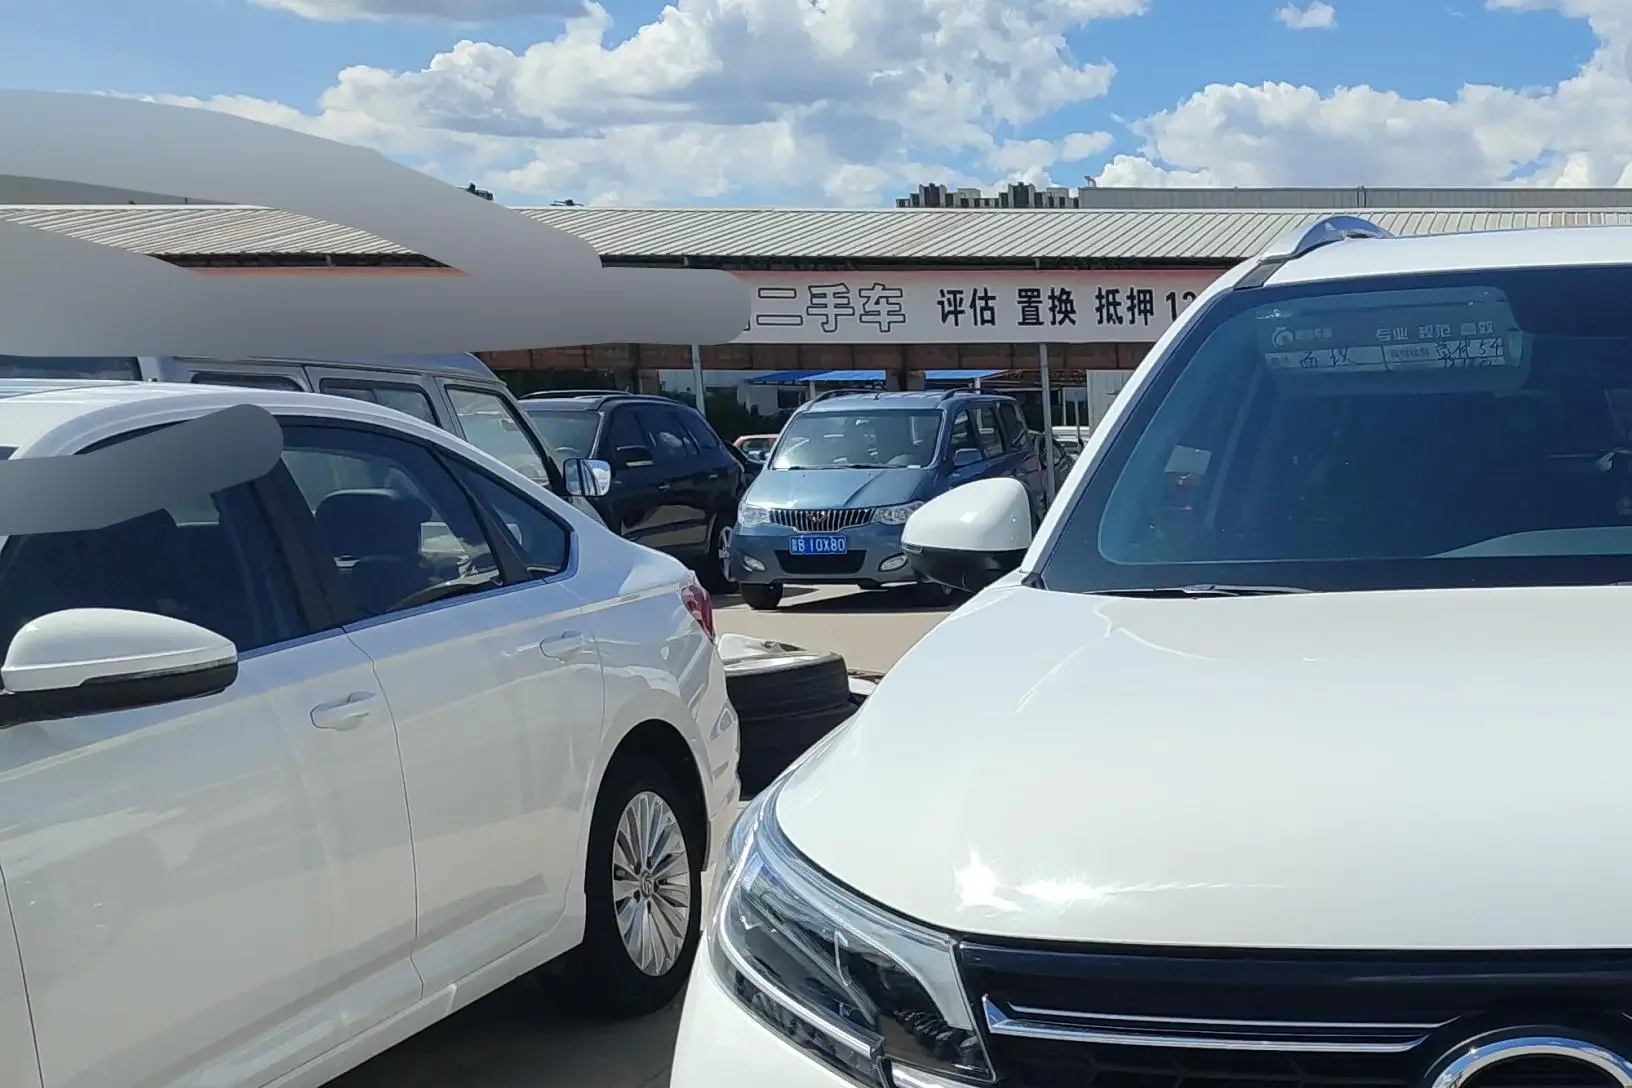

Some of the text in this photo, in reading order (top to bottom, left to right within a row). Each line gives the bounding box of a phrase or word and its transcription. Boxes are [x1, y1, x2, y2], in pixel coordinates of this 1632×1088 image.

[757, 283, 905, 332] 二手车
[937, 287, 997, 327] 评估
[1017, 287, 1076, 326] 置换
[1095, 287, 1154, 326] 抵押
